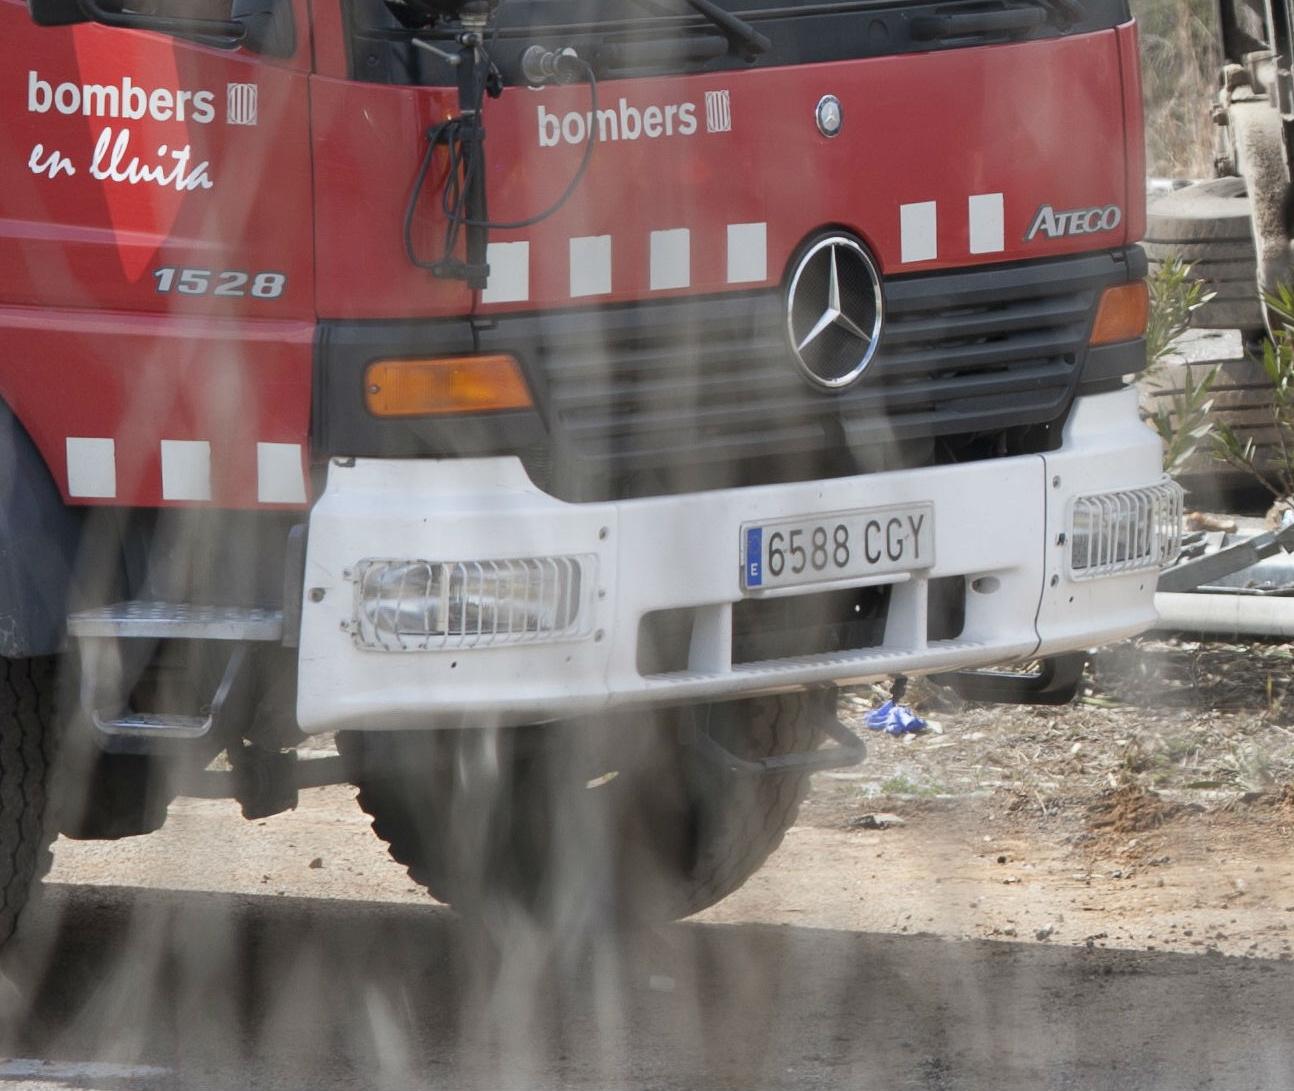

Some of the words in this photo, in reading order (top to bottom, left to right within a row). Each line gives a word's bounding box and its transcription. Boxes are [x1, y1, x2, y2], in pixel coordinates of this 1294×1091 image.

[28, 70, 216, 124] bombers
[538, 98, 698, 147] bombers
[28, 143, 76, 179] en
[89, 126, 214, 191] lluita
[1023, 204, 1122, 242] ATEGO
[153, 267, 286, 299] 1528
[768, 523, 850, 577] 6588
[864, 514, 925, 564] CGY
